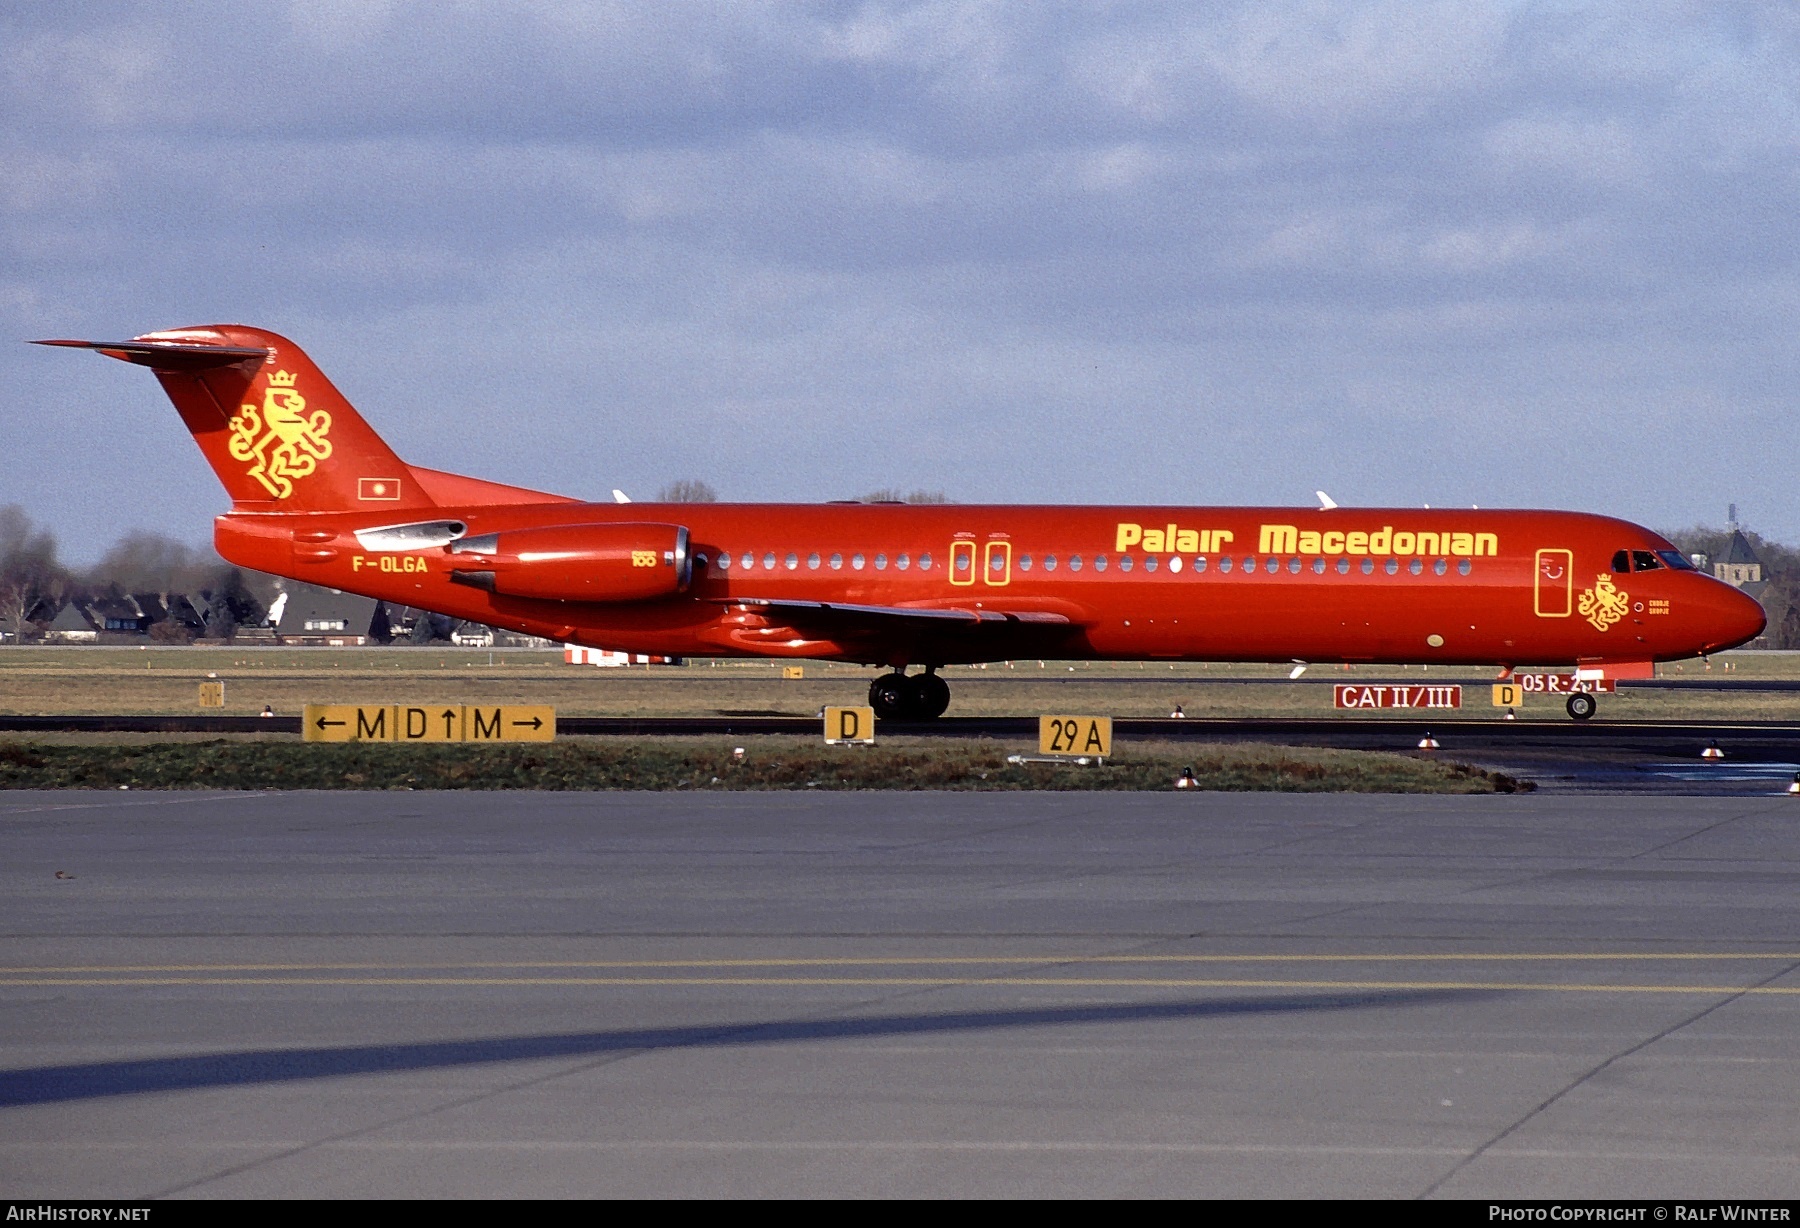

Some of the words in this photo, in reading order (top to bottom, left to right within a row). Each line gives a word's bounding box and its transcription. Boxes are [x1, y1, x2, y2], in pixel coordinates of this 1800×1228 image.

[1116, 523, 1234, 553] Palair
[1259, 525, 1498, 556] Macedonian
[353, 556, 428, 572] F-OLGA
[1342, 687, 1386, 708] CAT
[1502, 687, 1513, 704] D
[357, 708, 385, 738] M
[407, 708, 426, 738] D
[474, 708, 501, 738] M
[840, 710, 858, 738] D
[1050, 719, 1078, 751] 29
[1084, 720, 1103, 751] A
